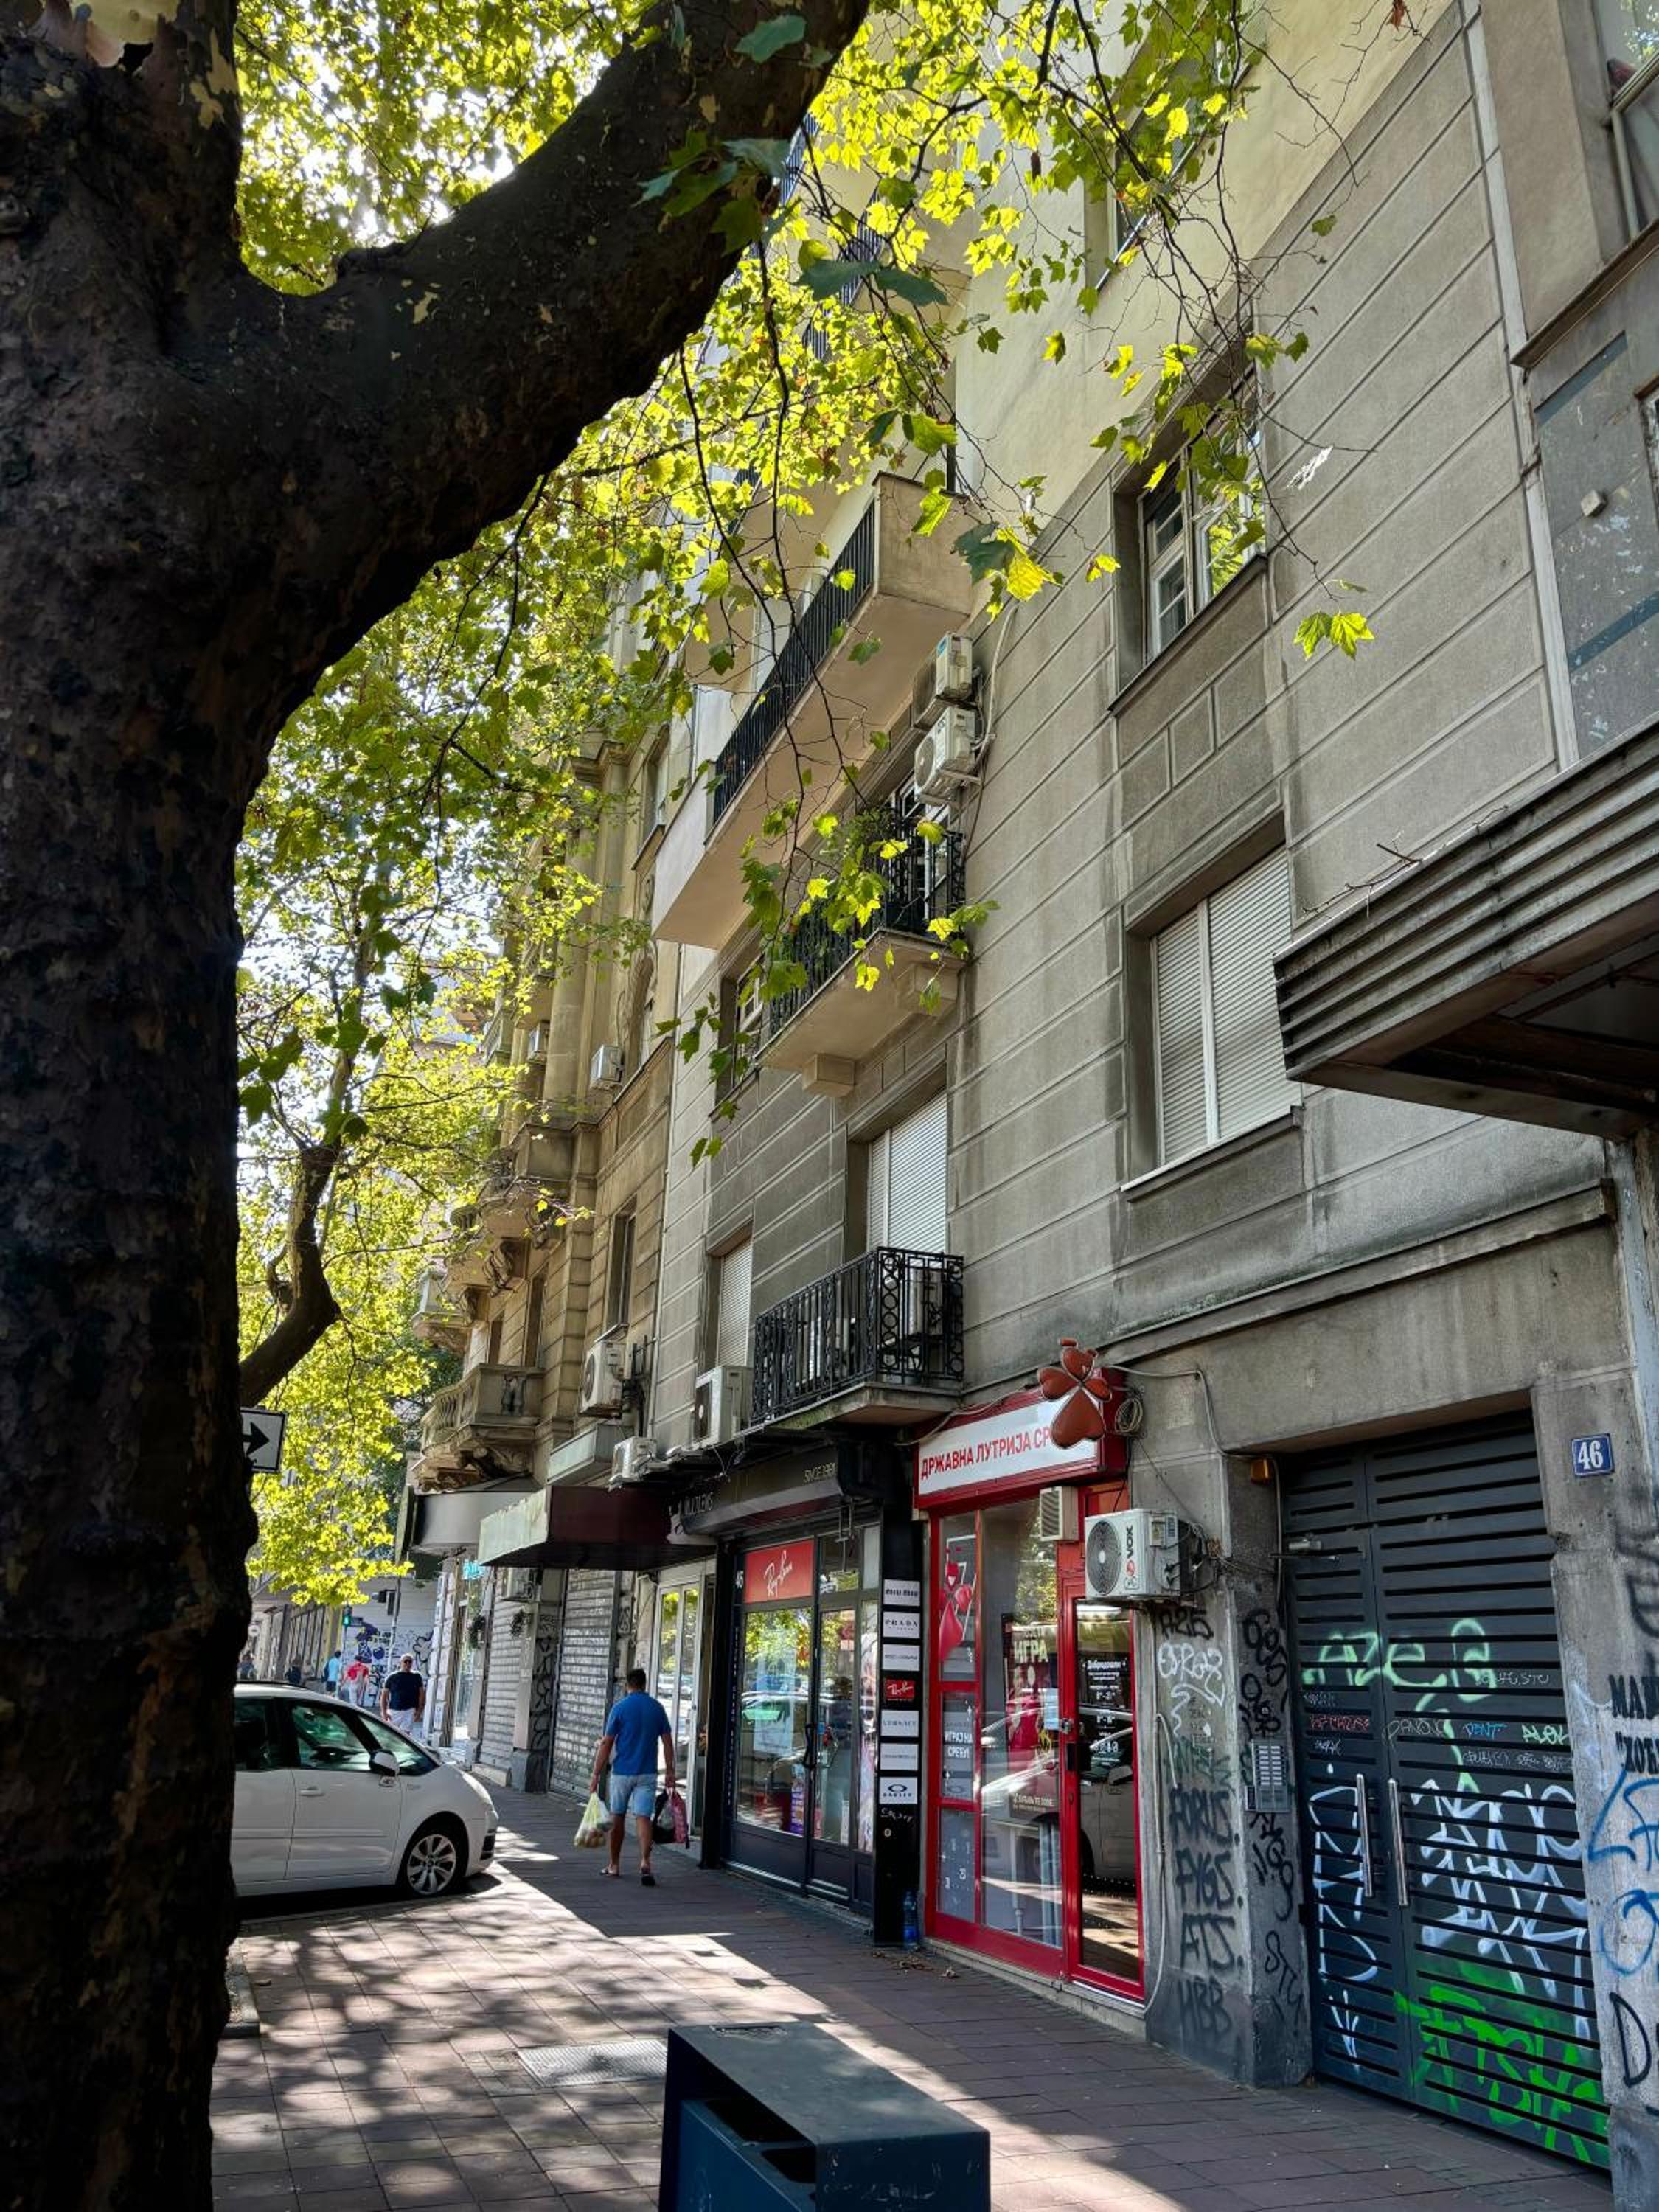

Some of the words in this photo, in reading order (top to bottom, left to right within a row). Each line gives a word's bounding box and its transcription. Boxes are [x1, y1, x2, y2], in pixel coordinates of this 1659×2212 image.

[920, 1444, 974, 1481] ДРЖАВНА
[975, 1432, 1032, 1464] ЛУТРИЈА
[1034, 1427, 1052, 1450] СР
[1576, 1441, 1604, 1471] 46
[1125, 1523, 1134, 1559] VOX
[885, 1619, 919, 1628] PRADA
